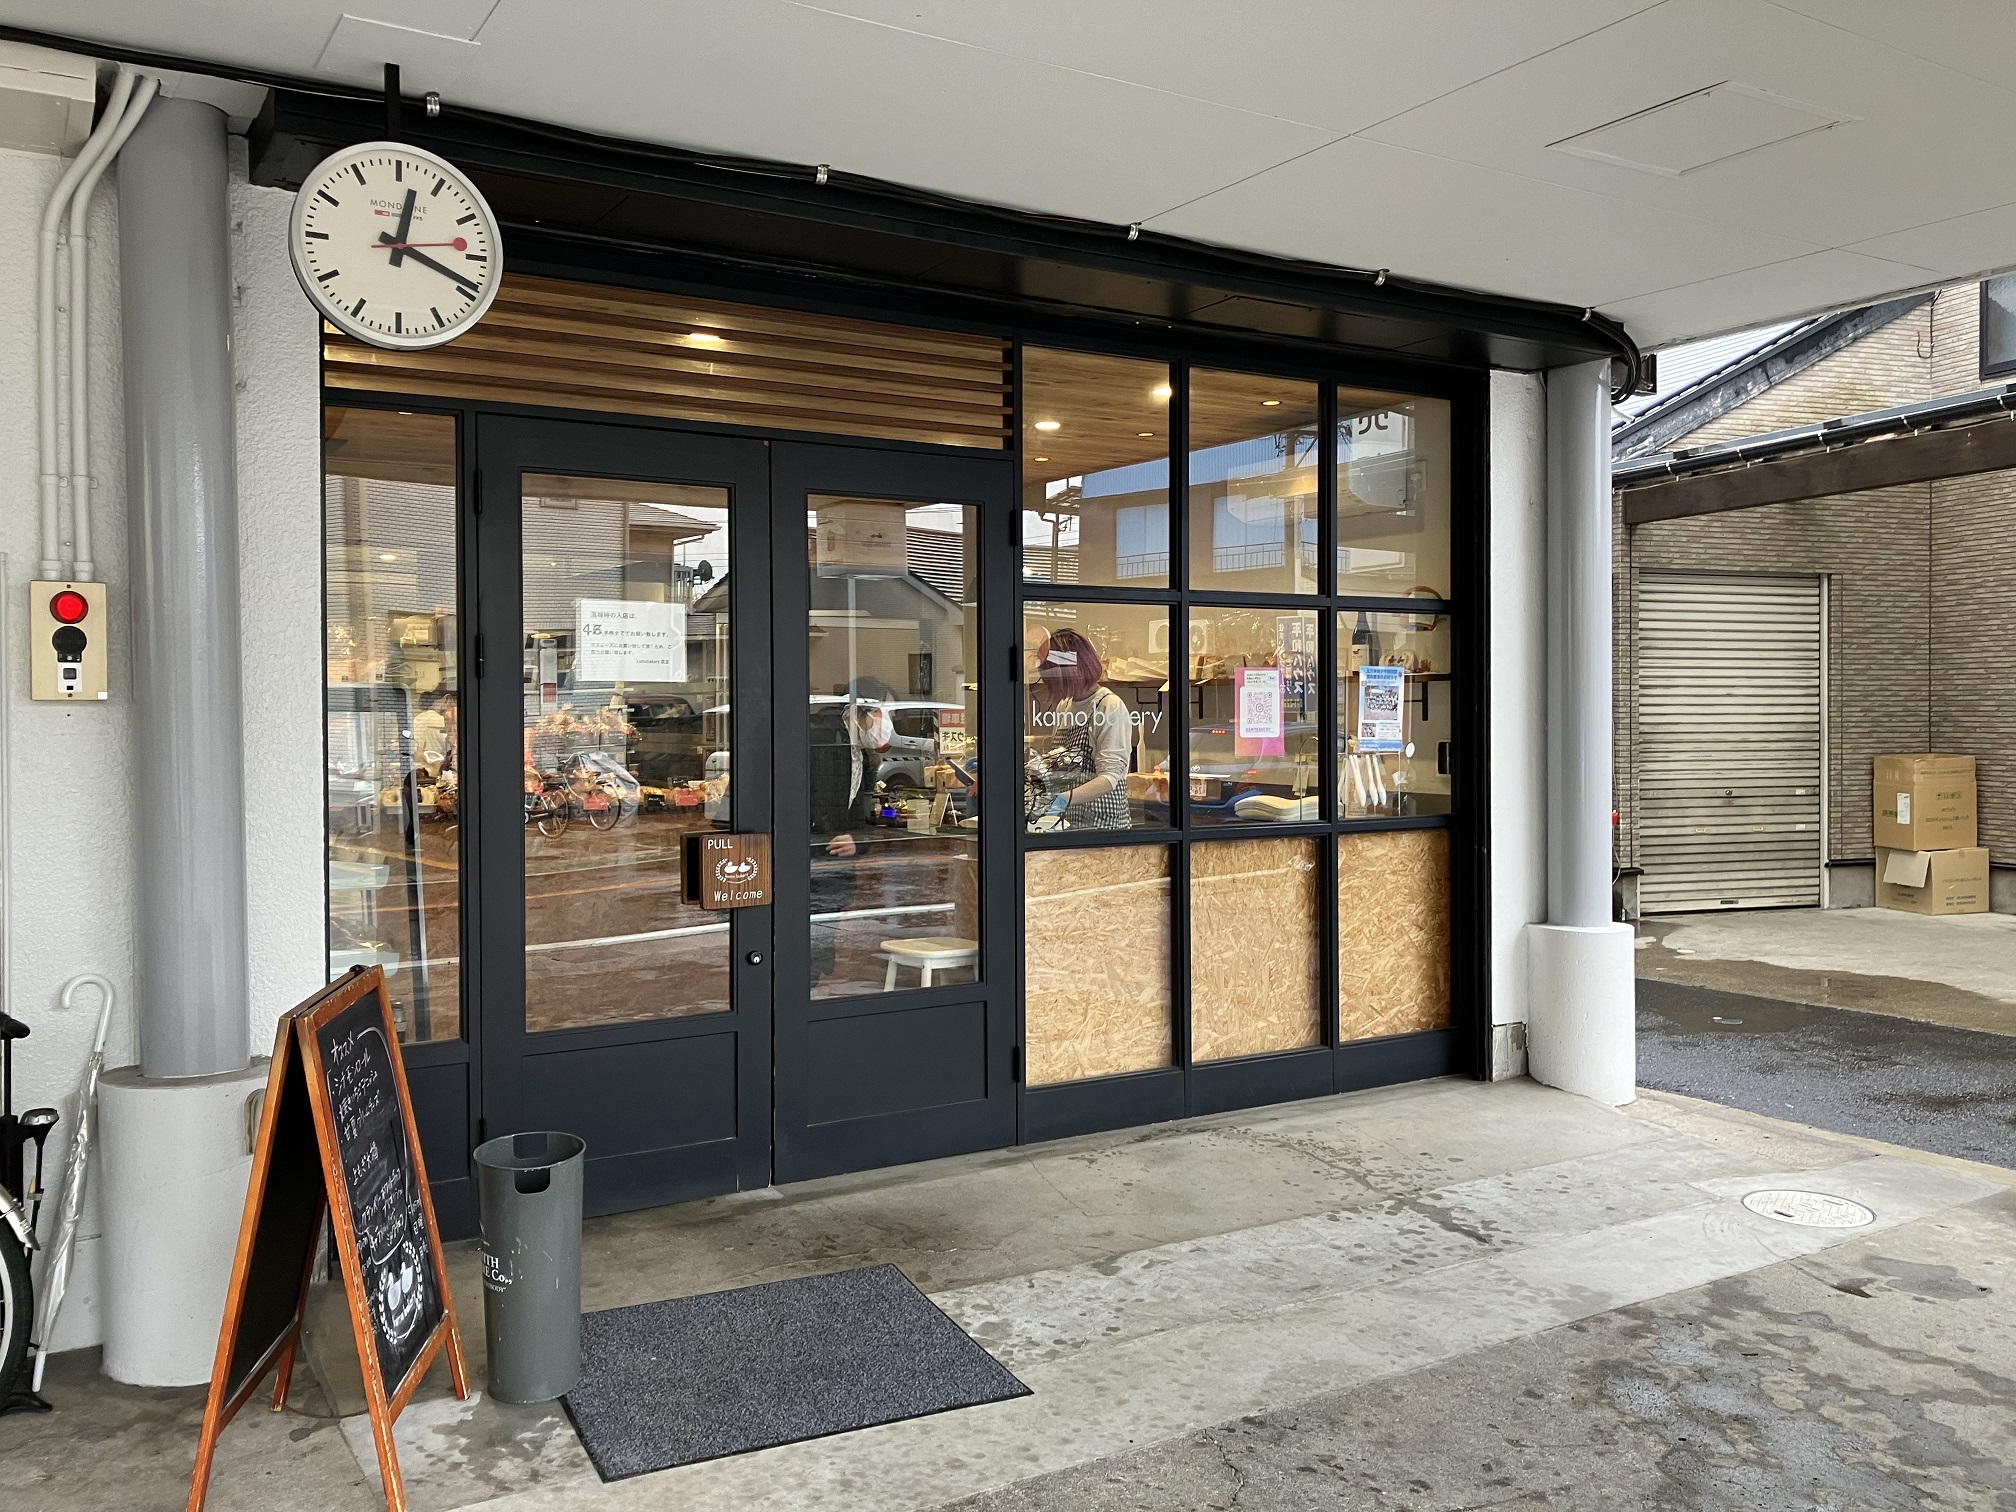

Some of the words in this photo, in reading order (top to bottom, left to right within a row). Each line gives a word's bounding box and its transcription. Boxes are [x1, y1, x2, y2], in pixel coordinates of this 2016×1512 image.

[370, 199, 427, 214] MONDNE
[1033, 700, 1088, 727] kamo
[707, 838, 733, 850] PULL
[714, 889, 763, 902] Welcome
[331, 1030, 354, 1066] オススメ
[482, 1251, 499, 1269] ITH
